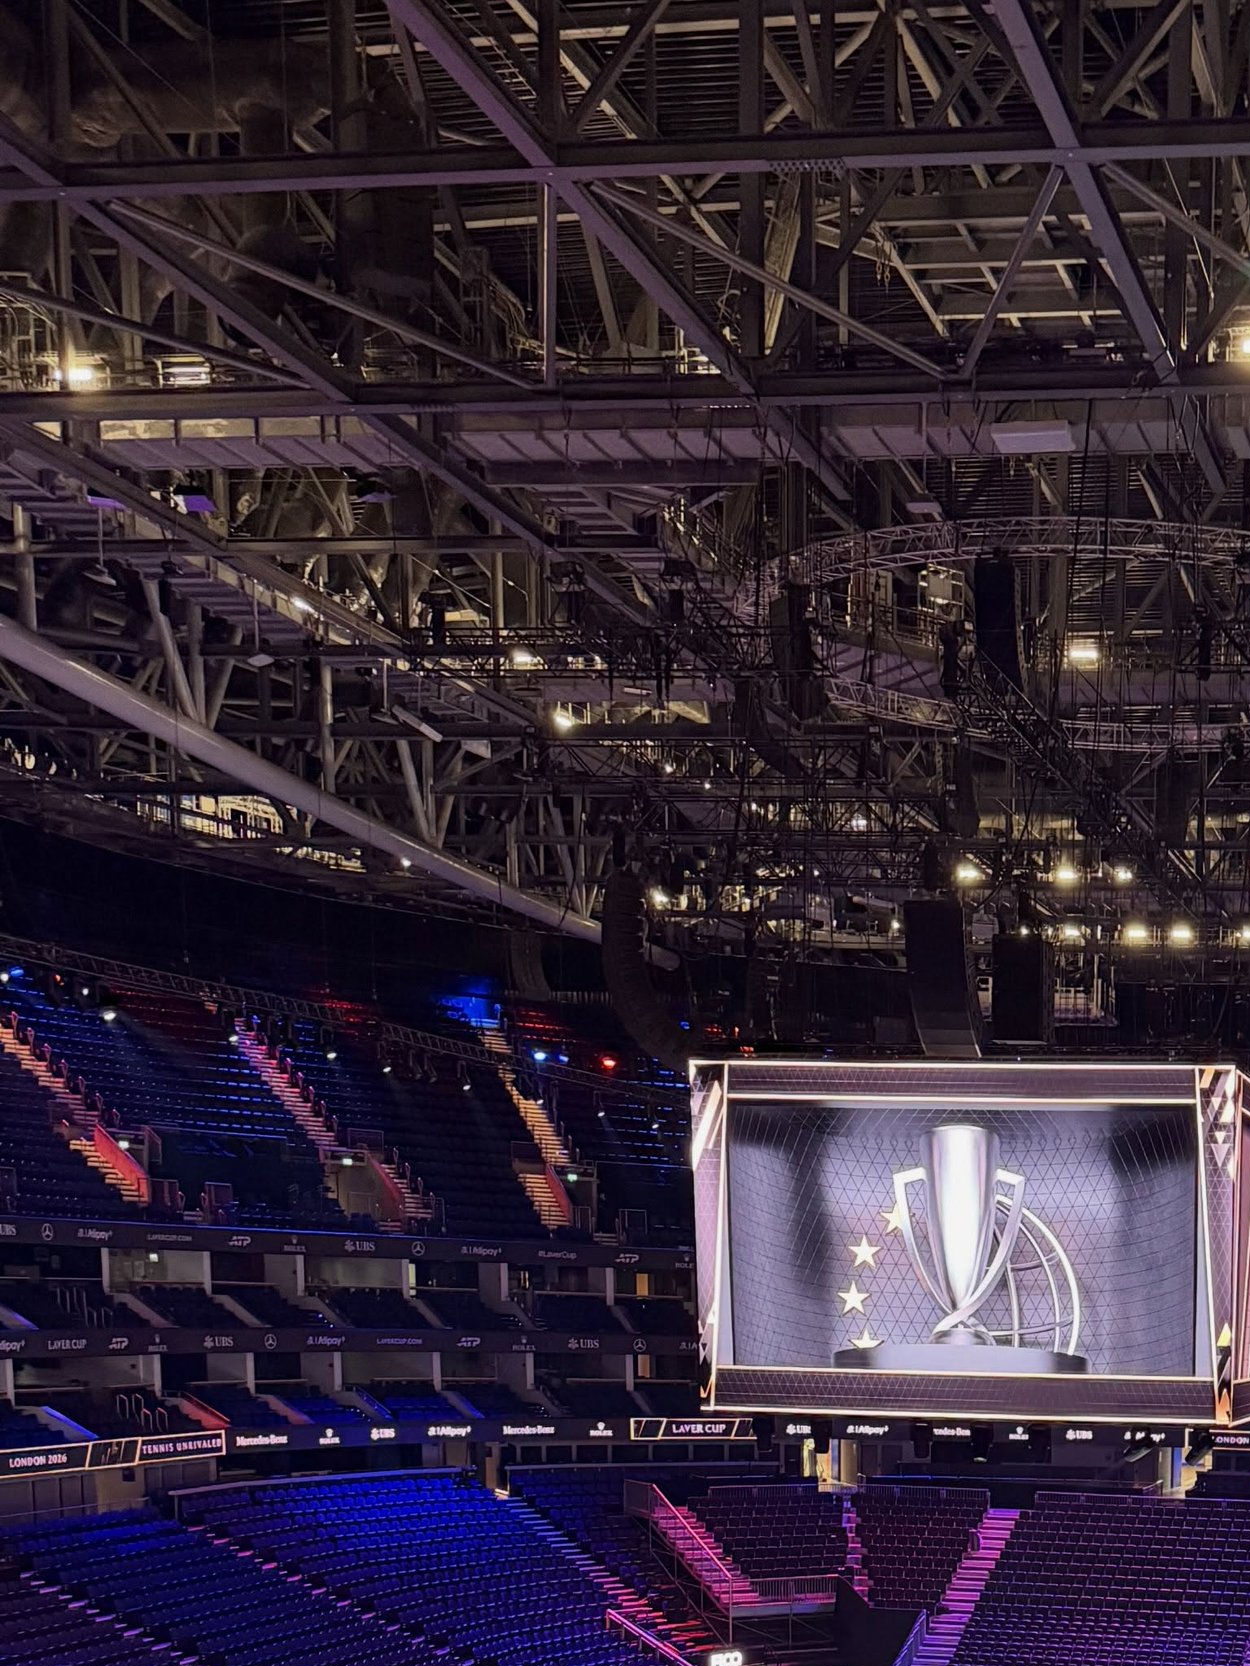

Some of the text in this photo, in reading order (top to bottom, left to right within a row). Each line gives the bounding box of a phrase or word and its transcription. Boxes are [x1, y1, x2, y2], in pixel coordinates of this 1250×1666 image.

[356, 1241, 376, 1252] UBS
[72, 1339, 87, 1349] CUP
[213, 1337, 234, 1348] UBS
[578, 1339, 599, 1350] UBS
[502, 1424, 556, 1437] Mercedes-Benz
[672, 1423, 726, 1434] LAVER CUP
[235, 1434, 288, 1447] Mercedes-Benz
[1214, 1435, 1250, 1446] ONDON
[142, 1438, 222, 1456] TENNIS UNRIVALED
[9, 1453, 68, 1469] LONDON 2026
